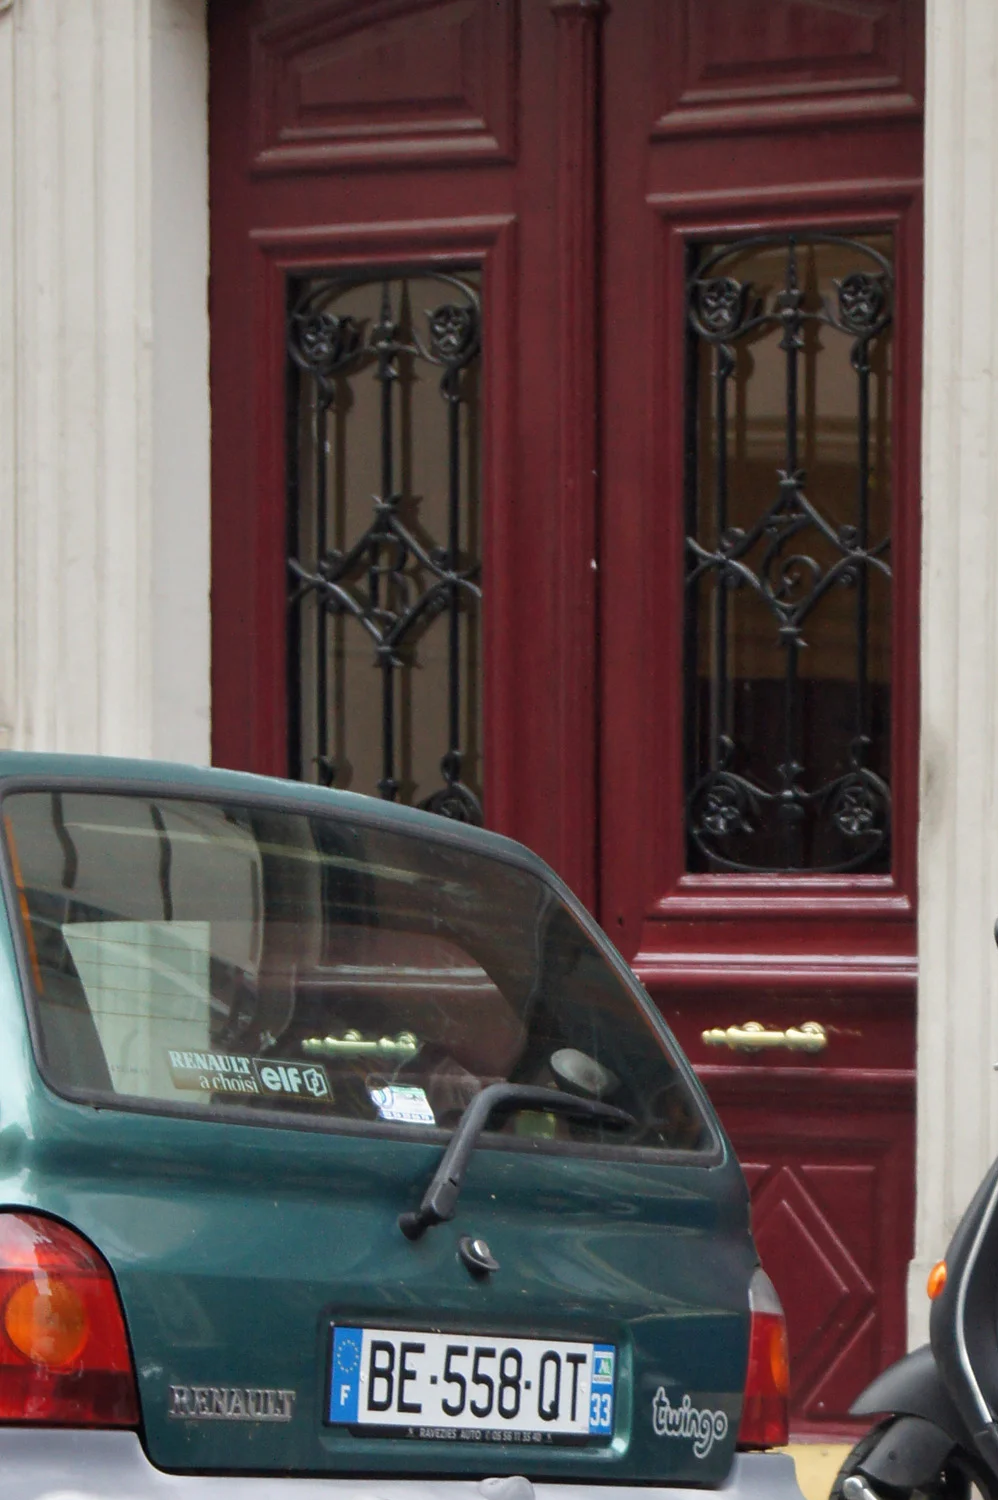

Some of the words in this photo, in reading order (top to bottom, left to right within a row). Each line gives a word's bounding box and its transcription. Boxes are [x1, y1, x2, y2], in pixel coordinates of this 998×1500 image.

[168, 1050, 250, 1074] RENAULT
[200, 1075, 211, 1089] a
[212, 1073, 260, 1094] choisi
[260, 1066, 302, 1093] elf
[168, 1385, 297, 1421] RENAULT
[340, 1384, 351, 1406] F
[590, 1392, 612, 1427] 33
[460, 1428, 482, 1441] AUTO
[652, 1386, 728, 1459] twingo
